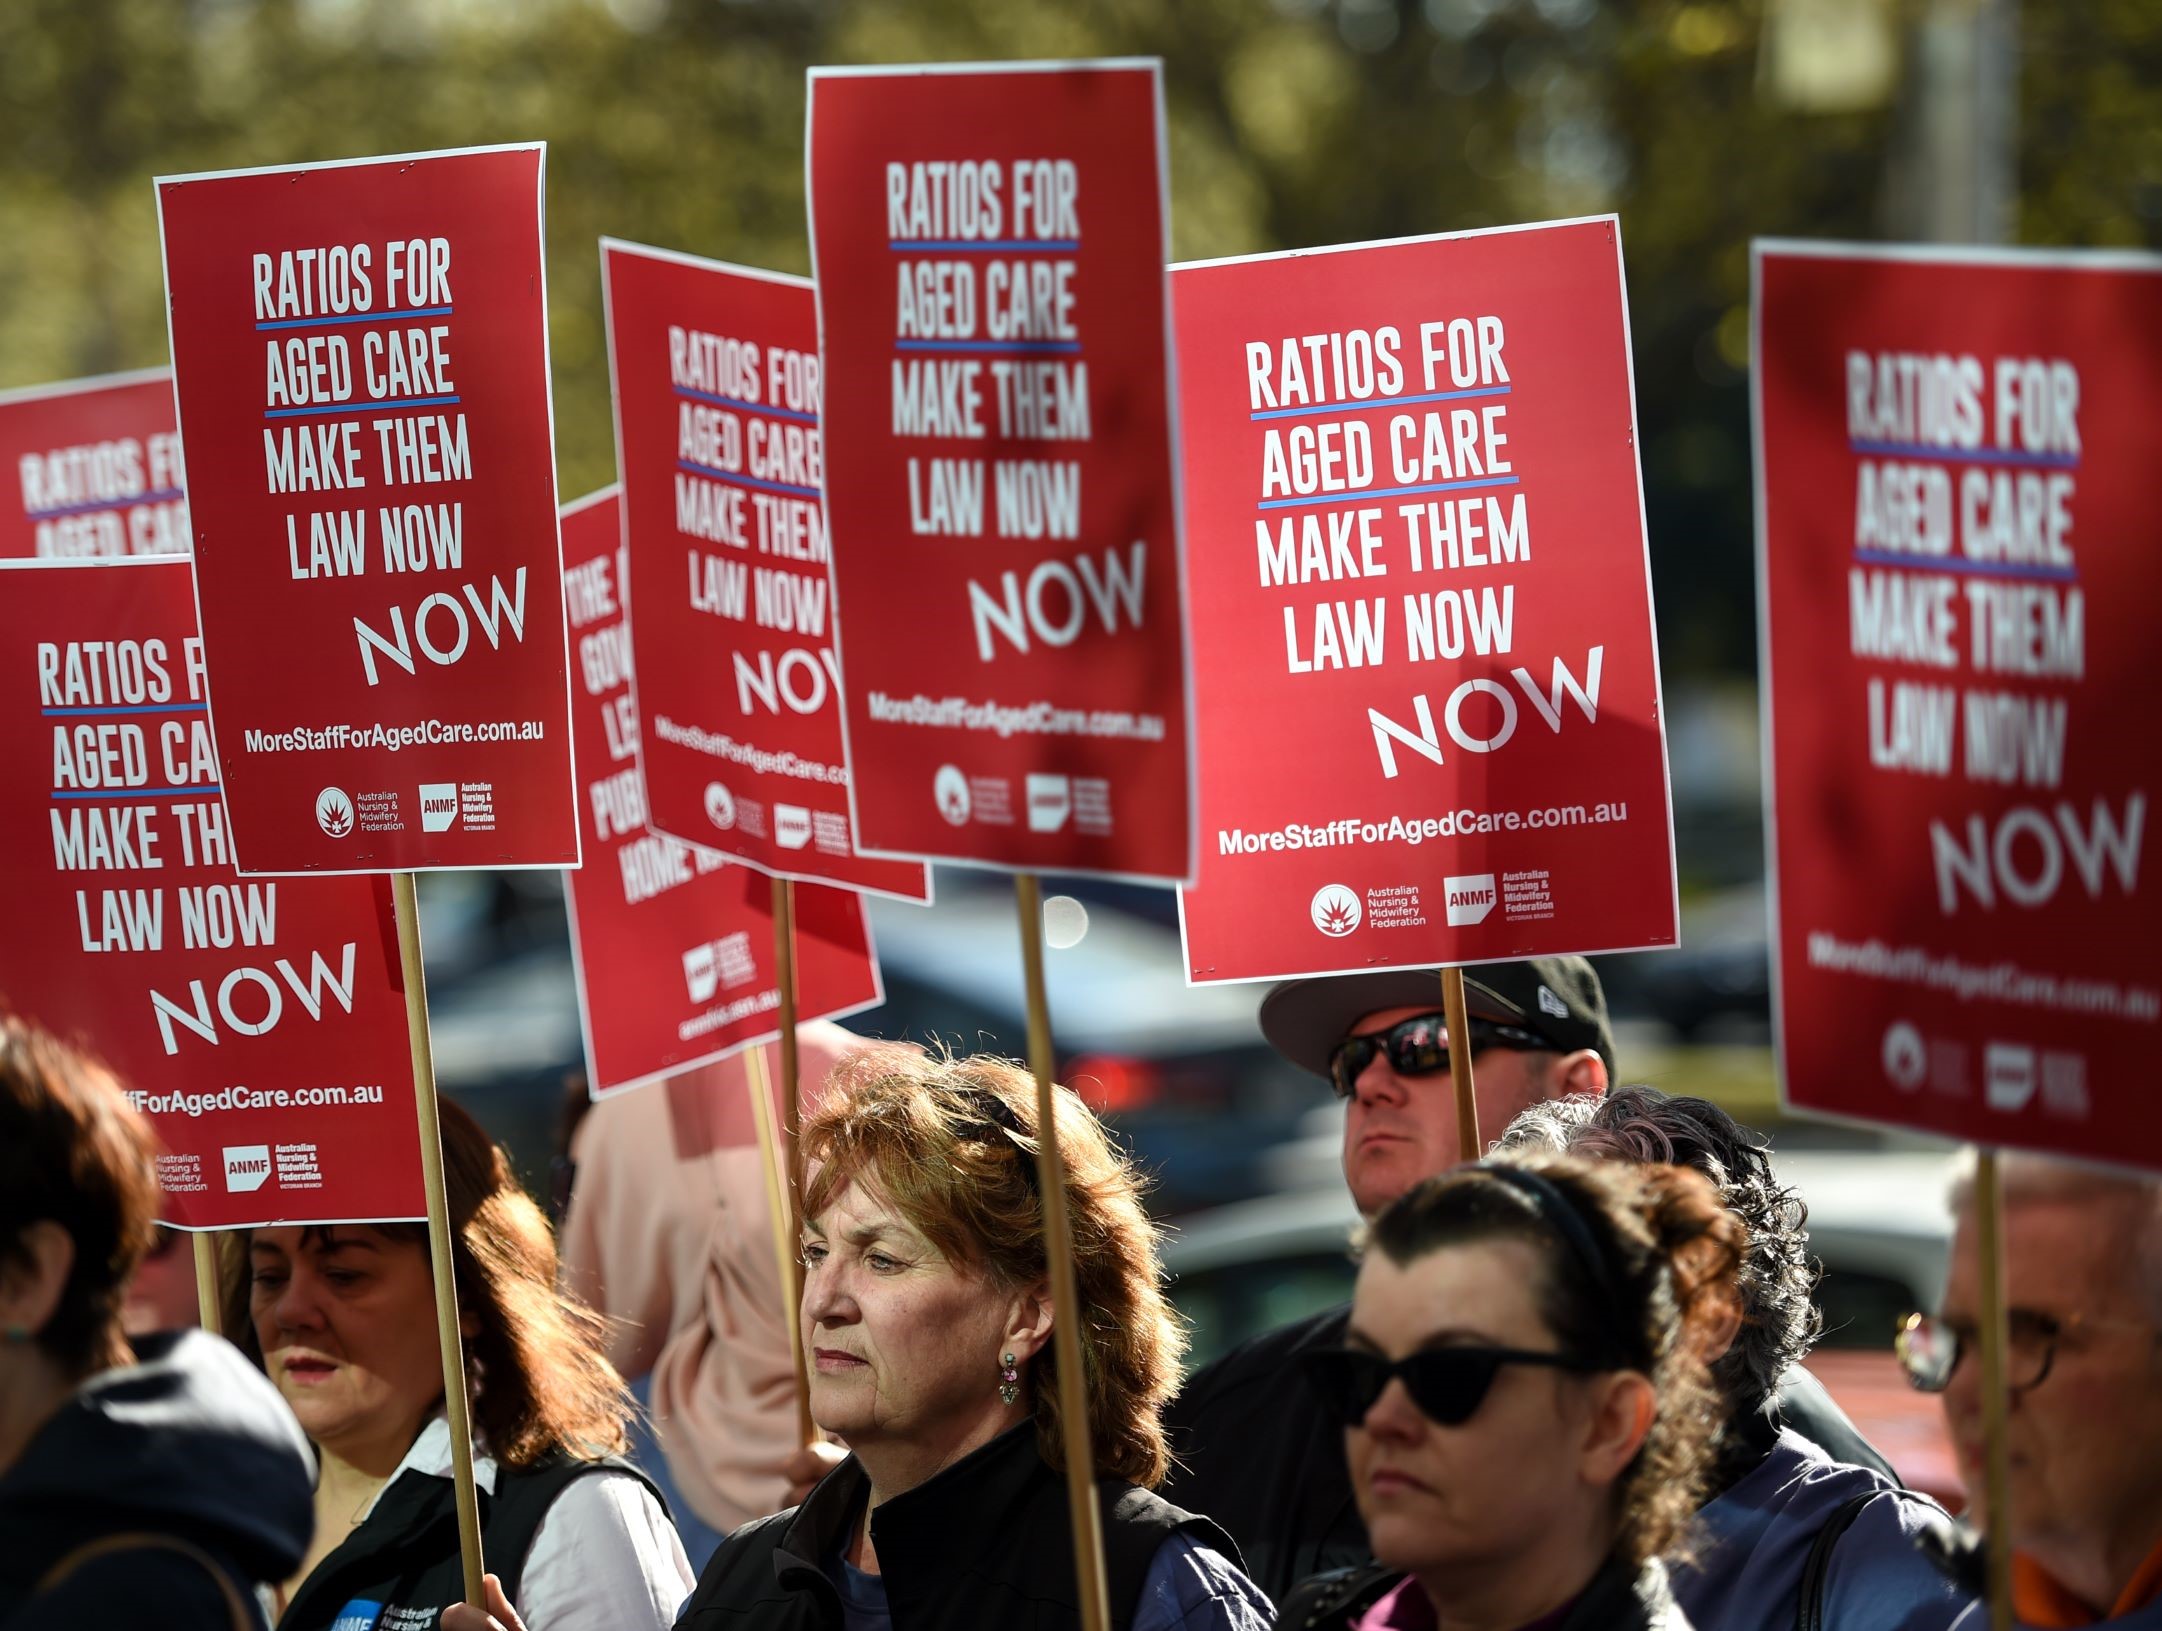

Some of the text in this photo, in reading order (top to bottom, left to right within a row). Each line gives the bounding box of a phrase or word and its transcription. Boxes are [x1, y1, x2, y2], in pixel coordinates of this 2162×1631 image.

[886, 159, 1080, 241] RATIOS FOR
[253, 237, 453, 319] RATIOS FOR
[897, 260, 1078, 341] AGED CARE
[267, 326, 454, 406] AGED CARE
[667, 325, 820, 414] RATIOS FOR
[1245, 315, 1511, 410] RATIOS FOR
[891, 358, 1091, 442] MAKE THEM
[1845, 349, 2082, 455] RATIOS FOR
[19, 437, 145, 515] RATIOS
[263, 413, 473, 494] MAKE THEM
[678, 401, 822, 489] AGED CARE
[1262, 405, 1512, 498] AGED CARE
[674, 473, 828, 565] MAKE THEM
[908, 457, 1080, 541] LAW NOW
[1855, 460, 2076, 568] AGED CARE
[286, 502, 462, 579] LAW NOW
[1255, 493, 1531, 587] MAKE THEM
[353, 566, 527, 686] NOW
[688, 549, 747, 622] LAW
[754, 565, 826, 638] NOW
[968, 540, 1147, 663] NOW
[1848, 566, 2085, 682] MAKE THEM
[1283, 584, 1514, 674] LAW NOW
[37, 639, 172, 705] RATIOS
[244, 719, 544, 752] MoreStaffForAgedCare.com.au
[1367, 645, 1604, 779] NOW
[1868, 678, 2067, 790] LAW NOW
[53, 719, 219, 788] AGED CA
[461, 782, 492, 792] Australian
[357, 791, 398, 801] Australian
[358, 802, 398, 812] Nursing &
[360, 812, 398, 823] Midwifery
[361, 822, 405, 832] Federation
[424, 799, 456, 814] ANMF
[462, 792, 492, 803] Nursing &
[462, 803, 493, 813] Midwifery
[463, 813, 495, 823] Federation
[1218, 802, 1627, 856] MoreStaffForAgedCare.com.au
[50, 802, 230, 870] MAKE TH
[1929, 790, 2146, 917] NOW
[1367, 885, 1419, 898] Australian
[1368, 896, 1419, 909] Nursing &
[1449, 889, 1494, 908] ANMF
[1502, 870, 1549, 882] Australian
[1503, 880, 1549, 893] Nursing &
[1504, 891, 1550, 903] Midwifery
[1505, 901, 1554, 913] Federation
[76, 883, 277, 952] LAW NOW
[1369, 906, 1420, 919] Midwifery
[1370, 916, 1426, 929] Federation
[1506, 914, 1533, 922] VICTORIAN
[150, 942, 356, 1055] NOW
[192, 1164, 200, 1172] &
[229, 1159, 268, 1174] ANMF
[275, 1144, 317, 1153] Australian
[276, 1152, 317, 1164] Nursing &
[277, 1162, 319, 1173] Midwifery
[278, 1172, 322, 1182] Federation
